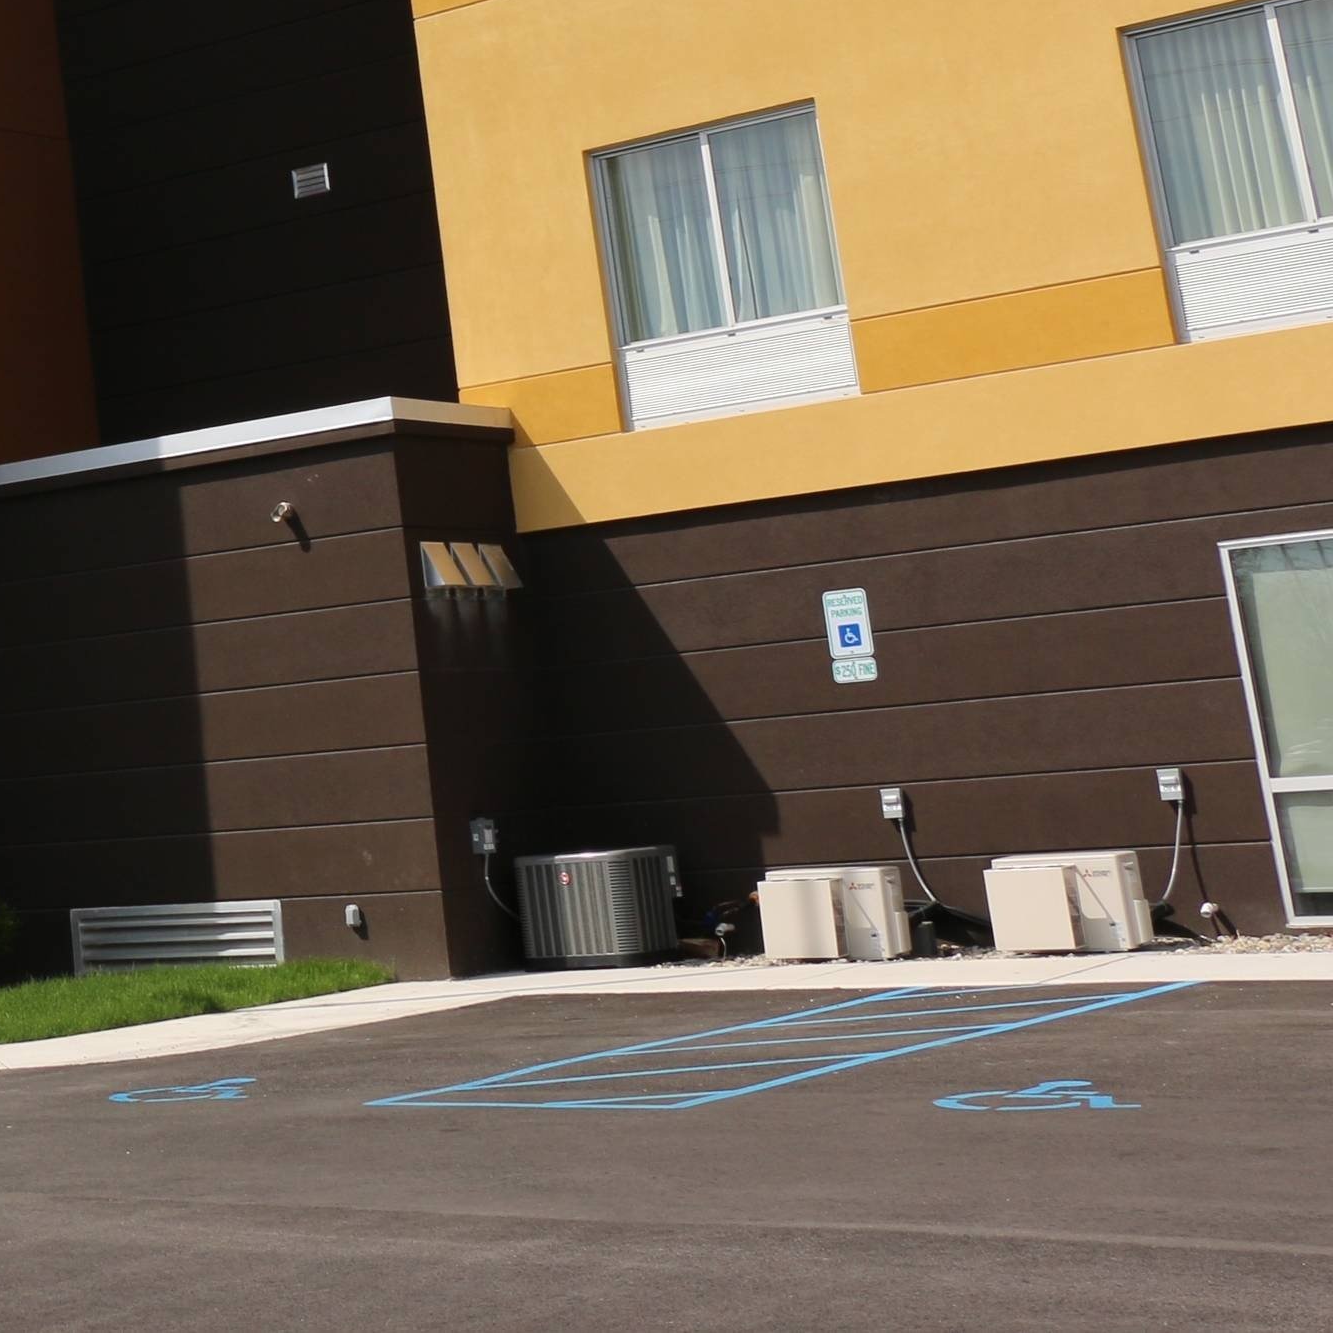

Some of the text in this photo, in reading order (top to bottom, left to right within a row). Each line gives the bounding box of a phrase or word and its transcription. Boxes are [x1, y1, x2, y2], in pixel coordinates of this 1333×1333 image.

[825, 595, 863, 607] RESERVED
[830, 606, 863, 618] PARKING
[858, 662, 876, 676] FINE
